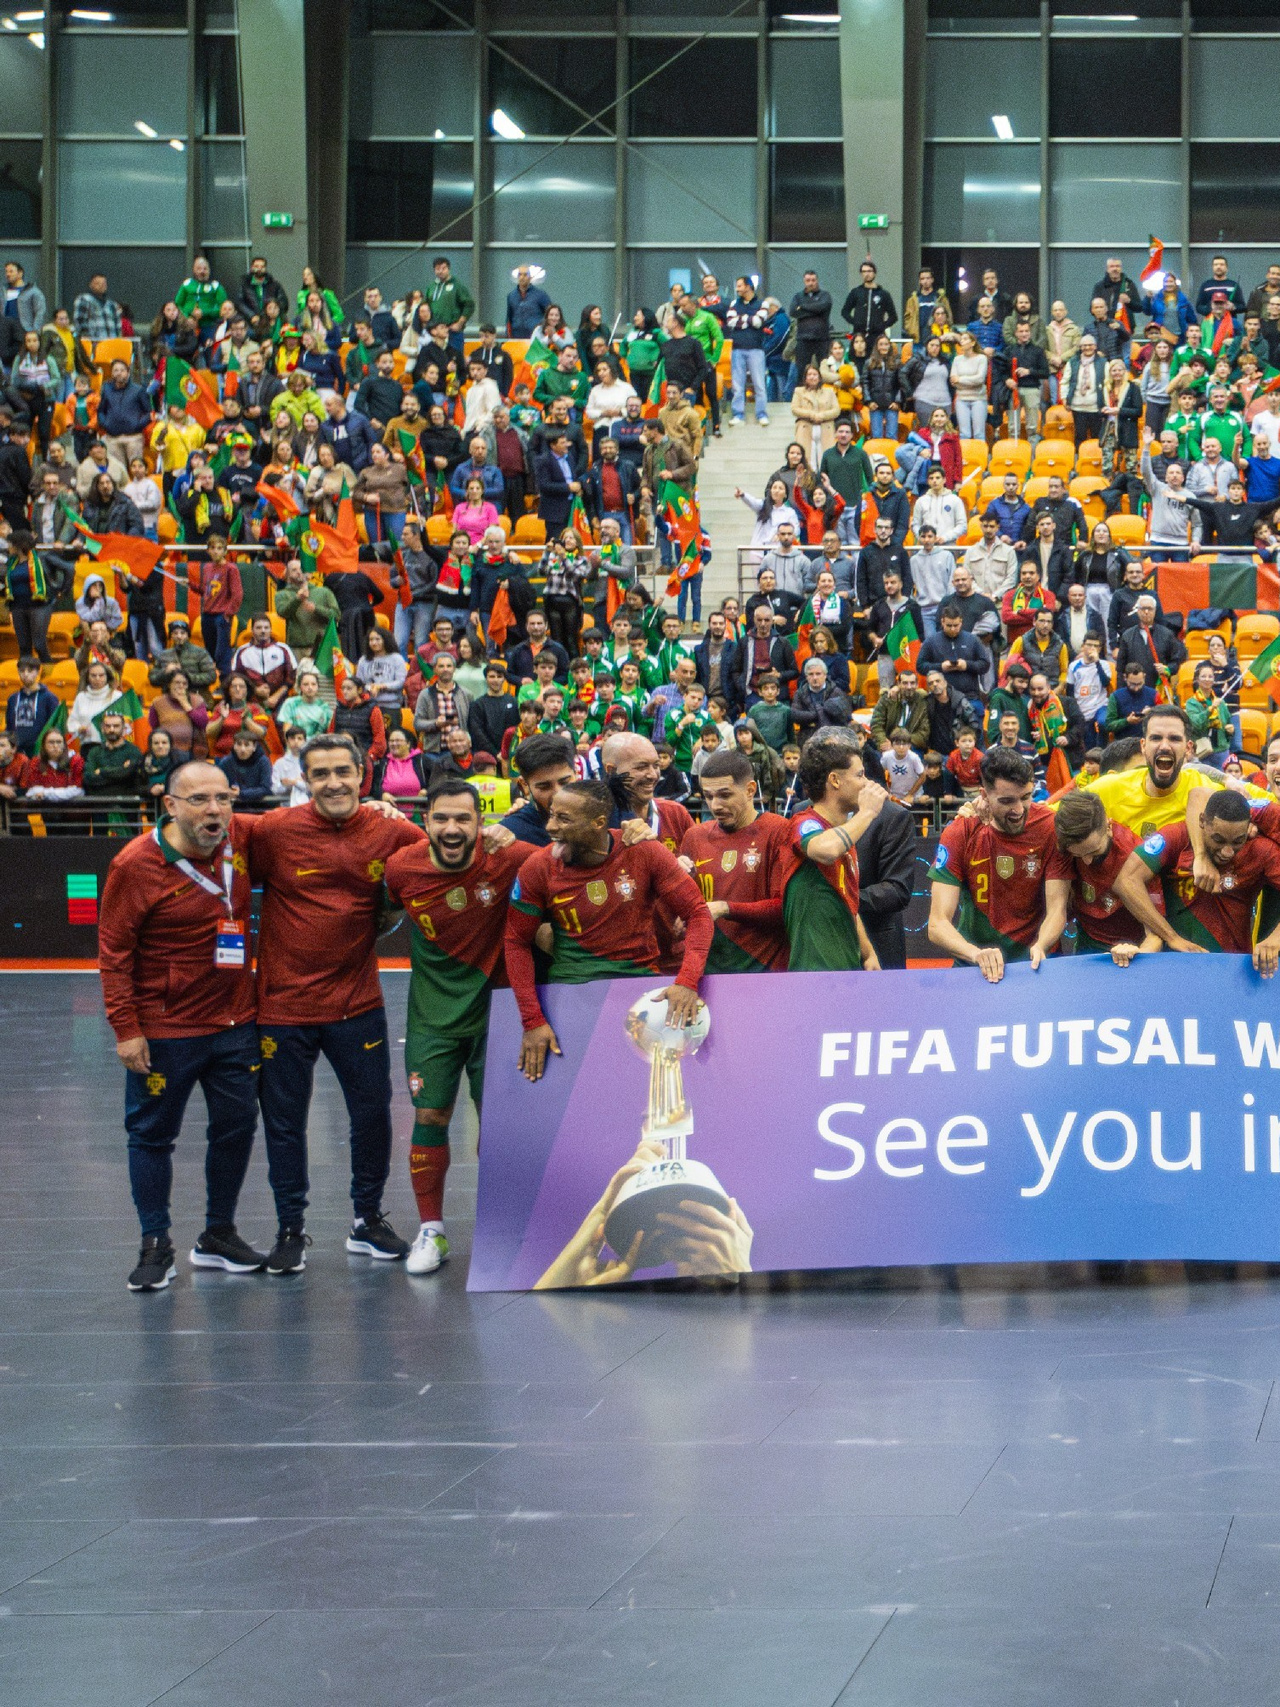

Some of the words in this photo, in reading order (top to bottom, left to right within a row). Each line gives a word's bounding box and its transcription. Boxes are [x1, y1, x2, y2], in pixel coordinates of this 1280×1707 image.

[976, 873, 989, 903] 2
[419, 913, 437, 939] 9
[558, 907, 582, 934] 11
[819, 1028, 957, 1078] FIFA
[976, 1017, 1216, 1072] FUTSAL
[813, 1102, 989, 1182] See
[1020, 1109, 1202, 1198] you
